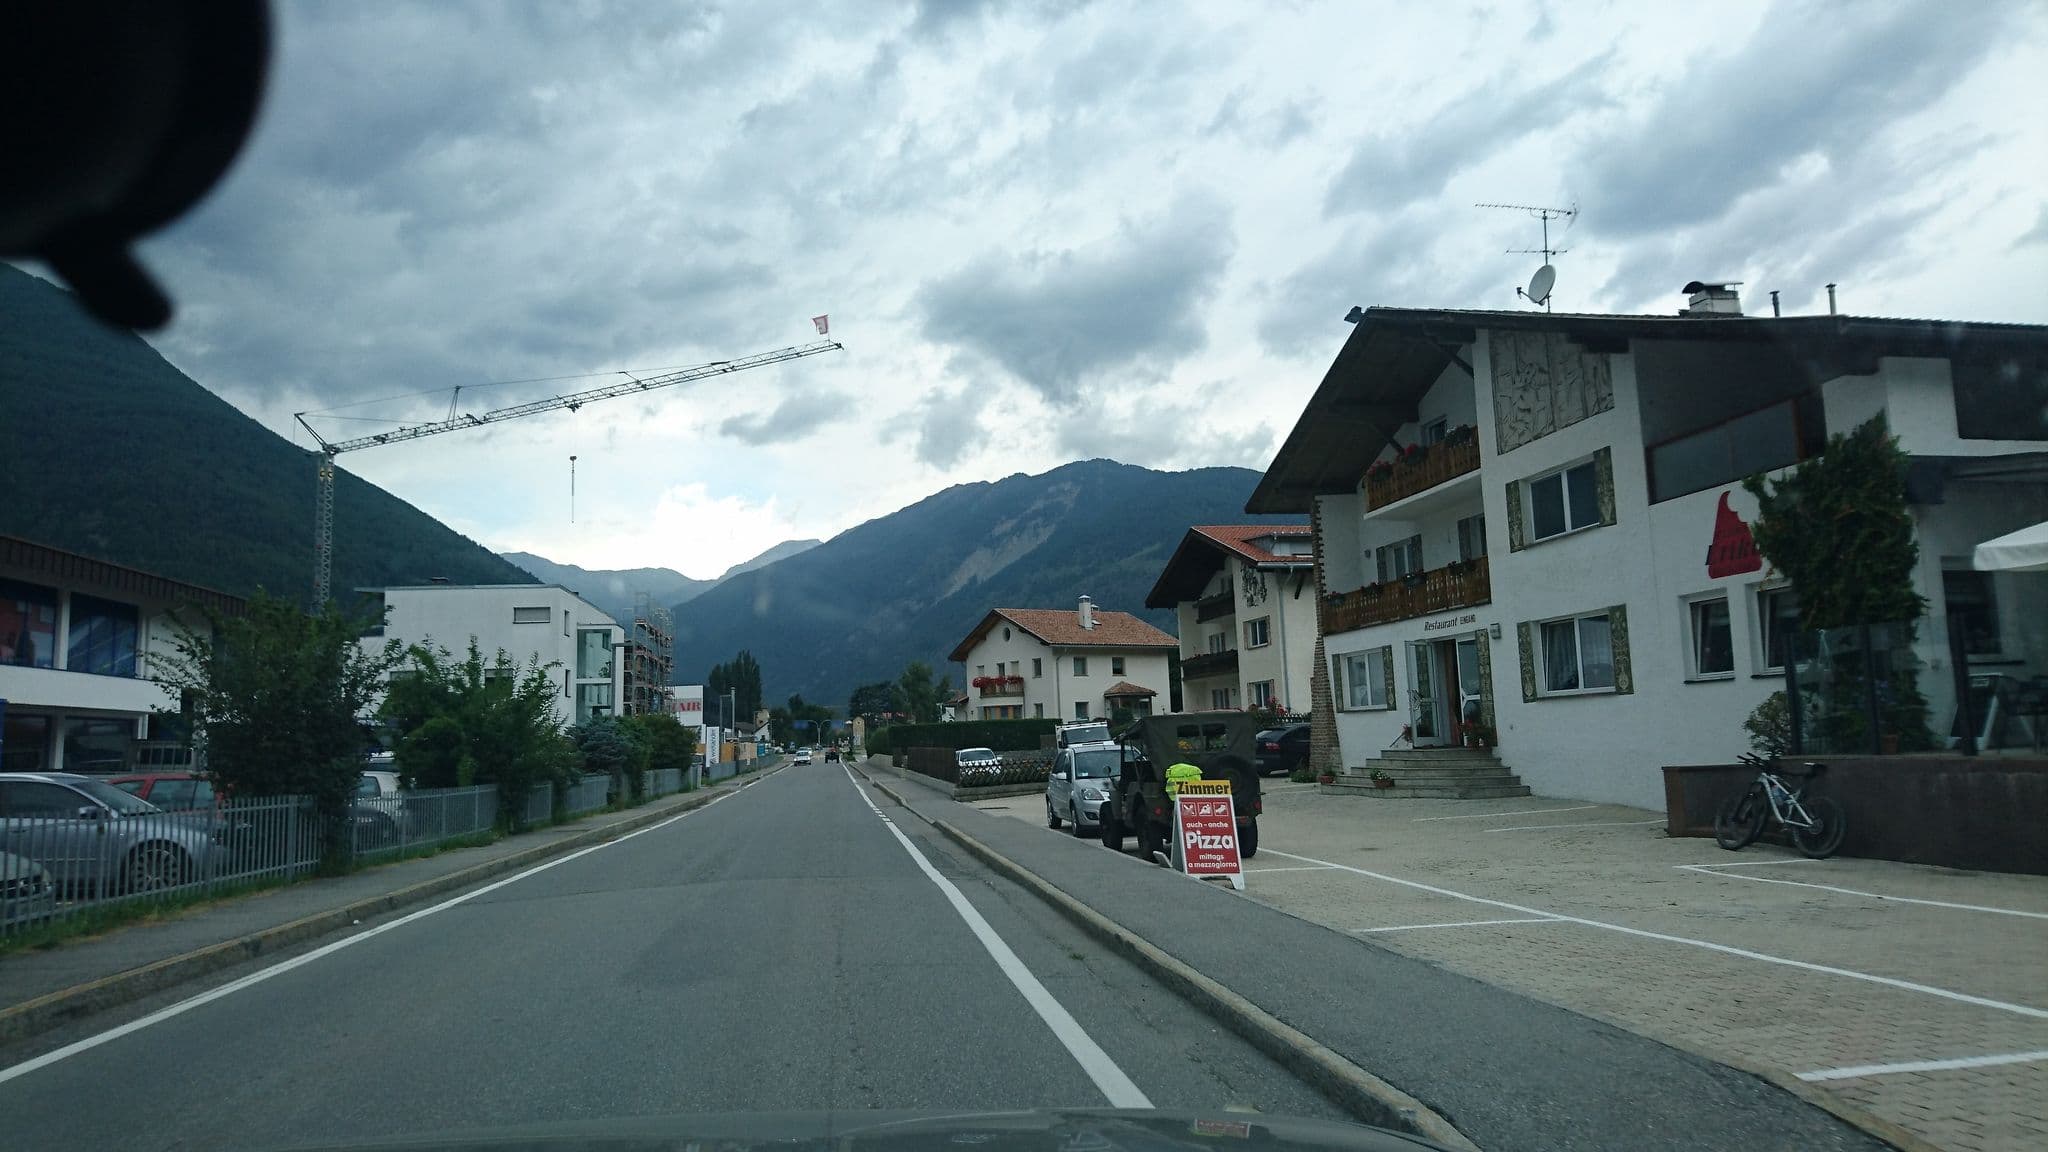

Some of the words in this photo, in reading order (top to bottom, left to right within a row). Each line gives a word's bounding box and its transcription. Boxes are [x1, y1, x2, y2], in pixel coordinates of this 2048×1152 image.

[1424, 617, 1457, 631] Restaurant
[1176, 781, 1230, 795] Zimmer
[1185, 830, 1234, 849] Pizza
[1194, 861, 1237, 869] mezzogiorno
